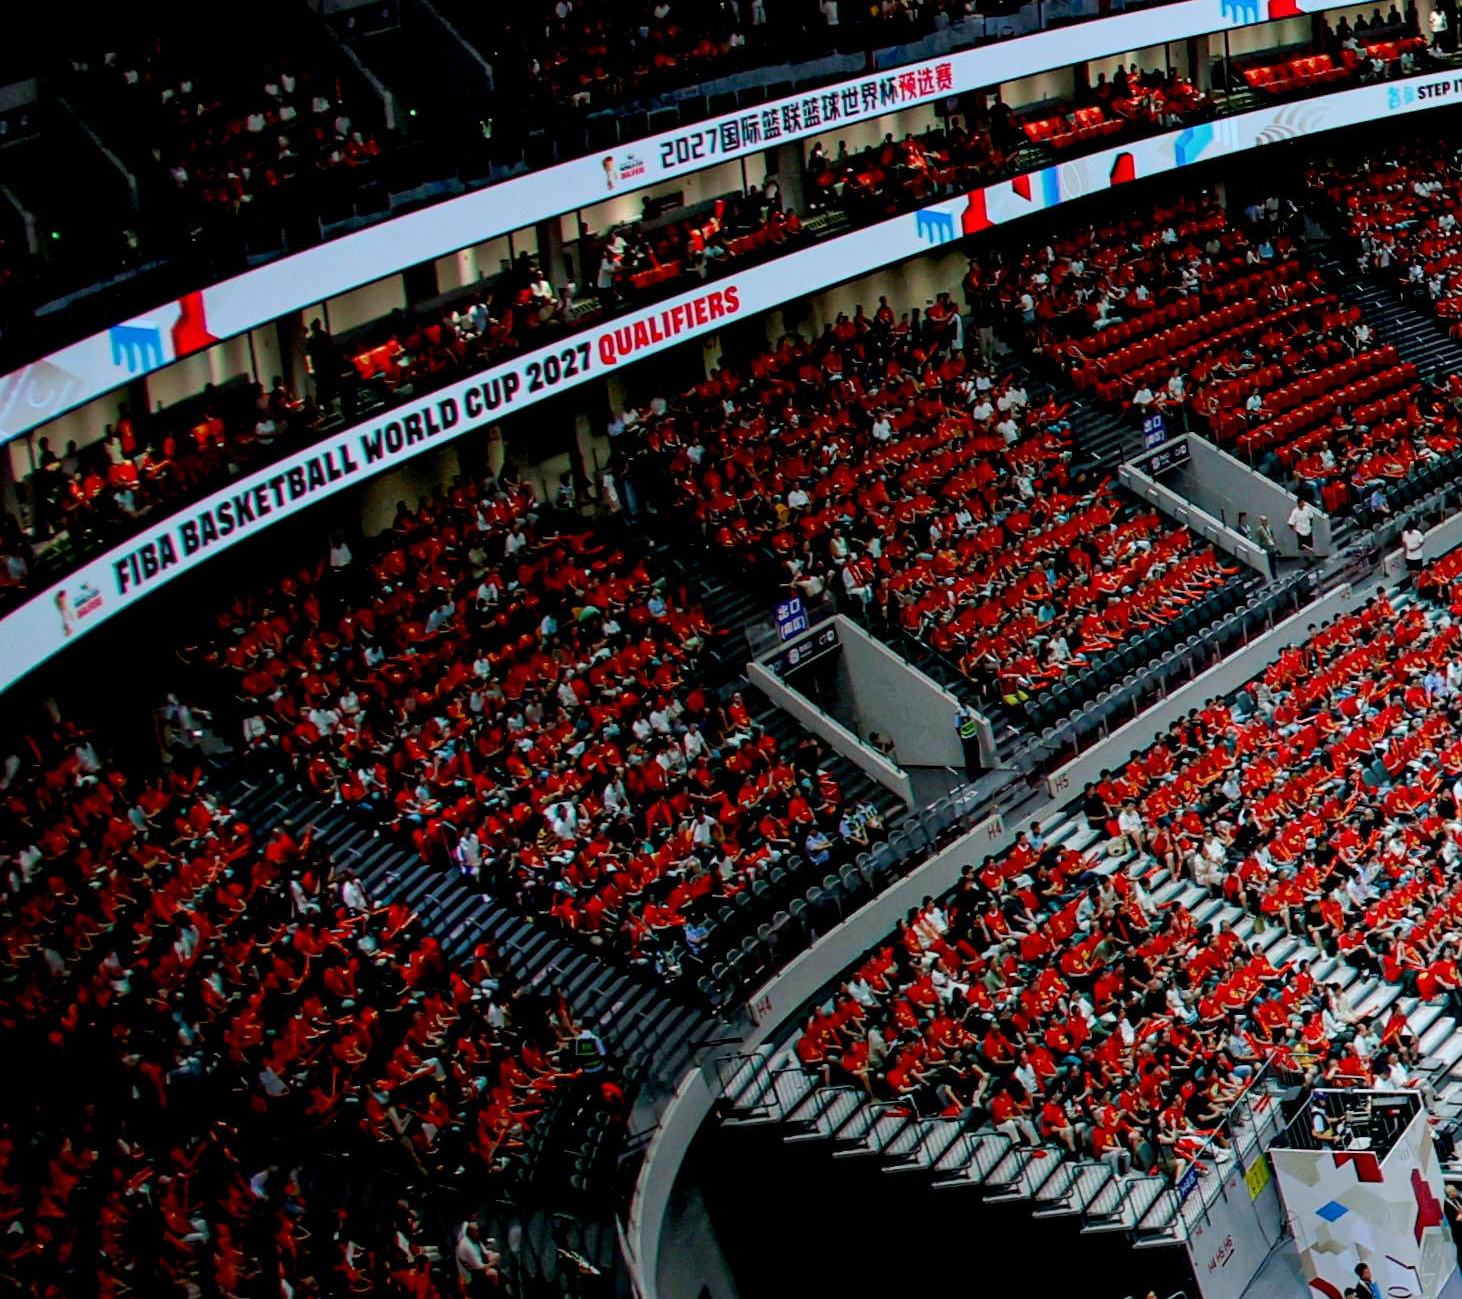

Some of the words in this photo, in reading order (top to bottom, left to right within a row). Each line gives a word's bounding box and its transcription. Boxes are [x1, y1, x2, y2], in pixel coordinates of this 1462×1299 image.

[1417, 79, 1451, 100] STEP
[1143, 415, 1162, 434] 出口
[111, 533, 178, 596] FIBA
[177, 443, 358, 557] BASKETBALL
[360, 397, 460, 466] WORLD
[465, 368, 520, 420] CUP
[526, 342, 592, 385] 2027
[598, 285, 740, 366] QUALIFIERS
[777, 597, 801, 621] 出口
